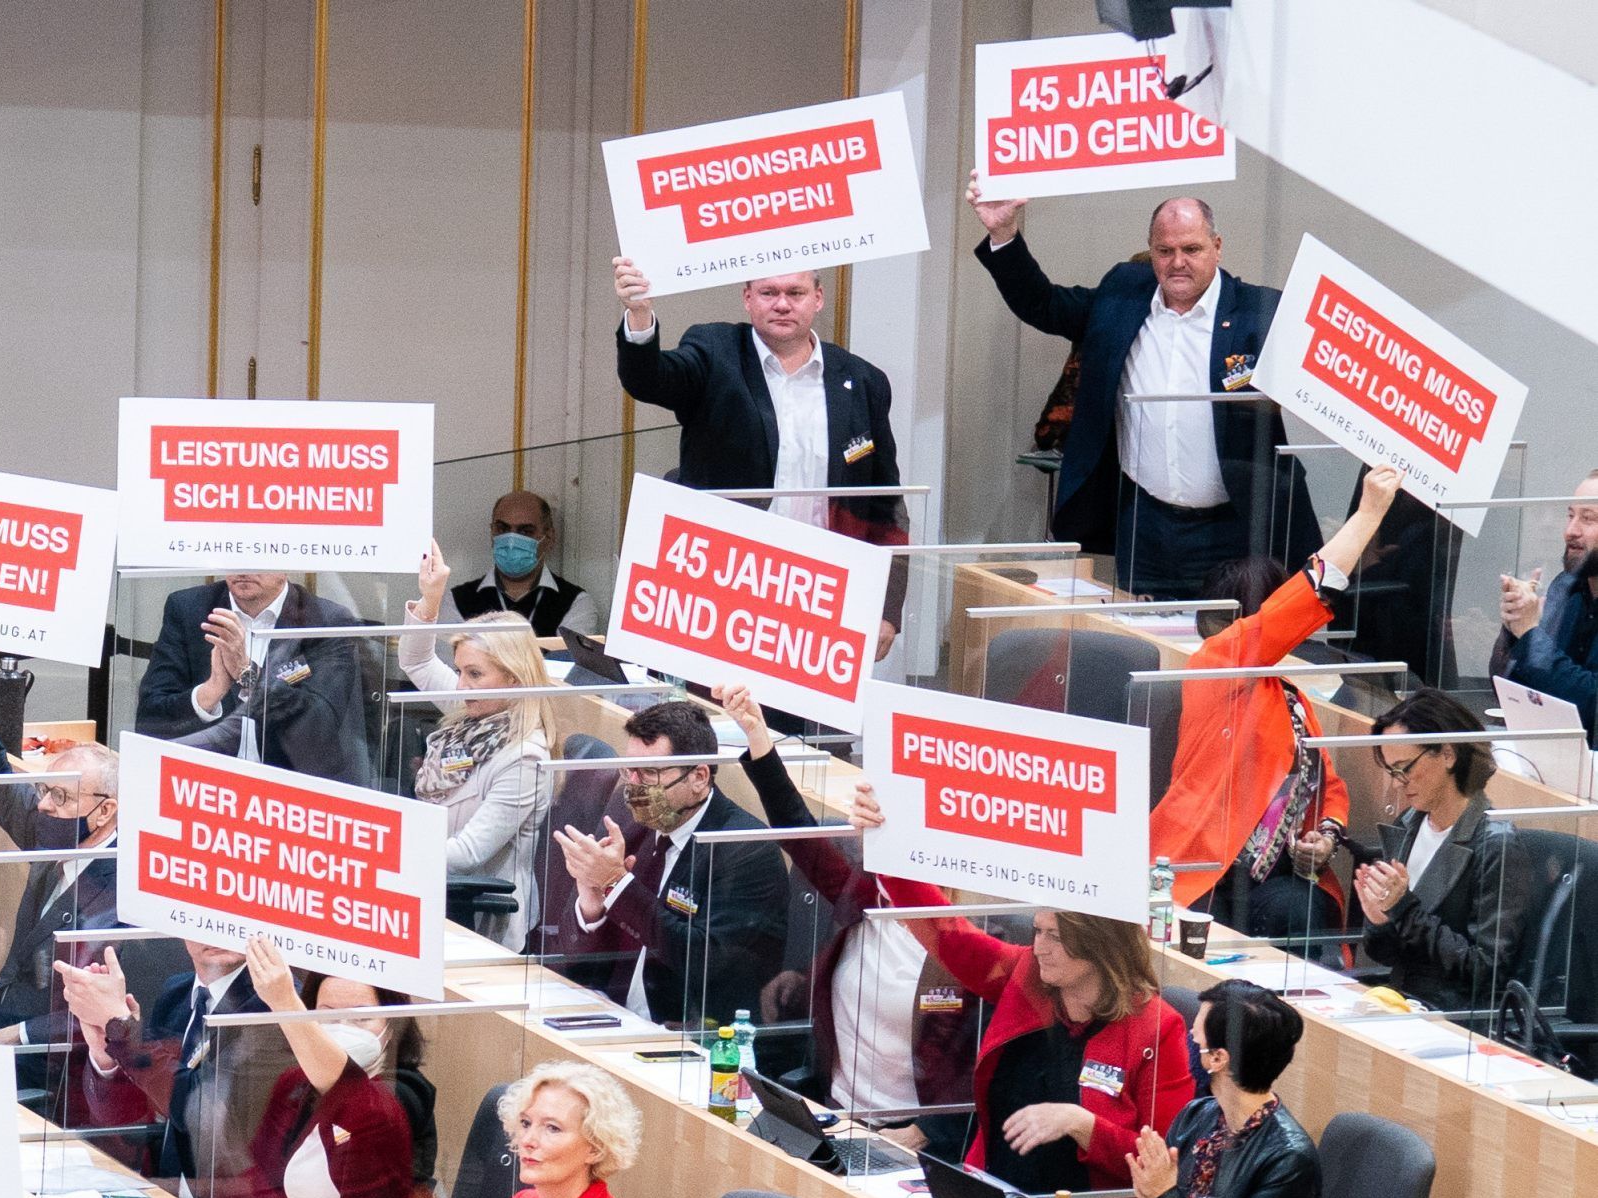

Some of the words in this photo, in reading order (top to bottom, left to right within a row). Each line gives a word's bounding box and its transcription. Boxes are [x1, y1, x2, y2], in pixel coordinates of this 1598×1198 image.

[1018, 75, 1061, 112] 45
[1066, 66, 1166, 111] JAHR
[652, 135, 867, 195] PENSIONSRAUB
[994, 123, 1079, 164] SIND
[1088, 112, 1218, 156] GENUG
[697, 183, 835, 227] STOPPEN!
[676, 234, 876, 277] 45-JAHRE-SIND-GENUG.AT
[1317, 294, 1423, 382] LEISTUNG
[1423, 367, 1485, 424] MUSS
[1314, 340, 1368, 390] SICH
[1366, 375, 1463, 456] LOHNEN!
[160, 440, 301, 470] LEISTUNG
[307, 442, 389, 471] MUSS
[1294, 387, 1448, 497] 45-JAHRE-SIND-GENUG.AT
[173, 482, 240, 509] SICH
[246, 484, 374, 513] LOHNEN!
[169, 540, 378, 557] 45-JAHRE-SIND-GENUG.AT
[665, 532, 710, 579] 45
[713, 547, 838, 620] JAHRE
[631, 579, 718, 640] SIND
[725, 609, 855, 684] GENUG
[903, 732, 1105, 794] PENSIONSRAUB
[171, 776, 238, 818] WER
[243, 795, 391, 853] ARBEITET
[939, 787, 1067, 837] STOPPEN!
[191, 821, 271, 864] DARF
[278, 842, 368, 888] NICHT
[909, 850, 1099, 897] 45-JAHRE-SIND-GENUG.AT
[148, 850, 207, 891] DER
[216, 866, 325, 919] DUMME
[332, 896, 409, 940] SEIN!
